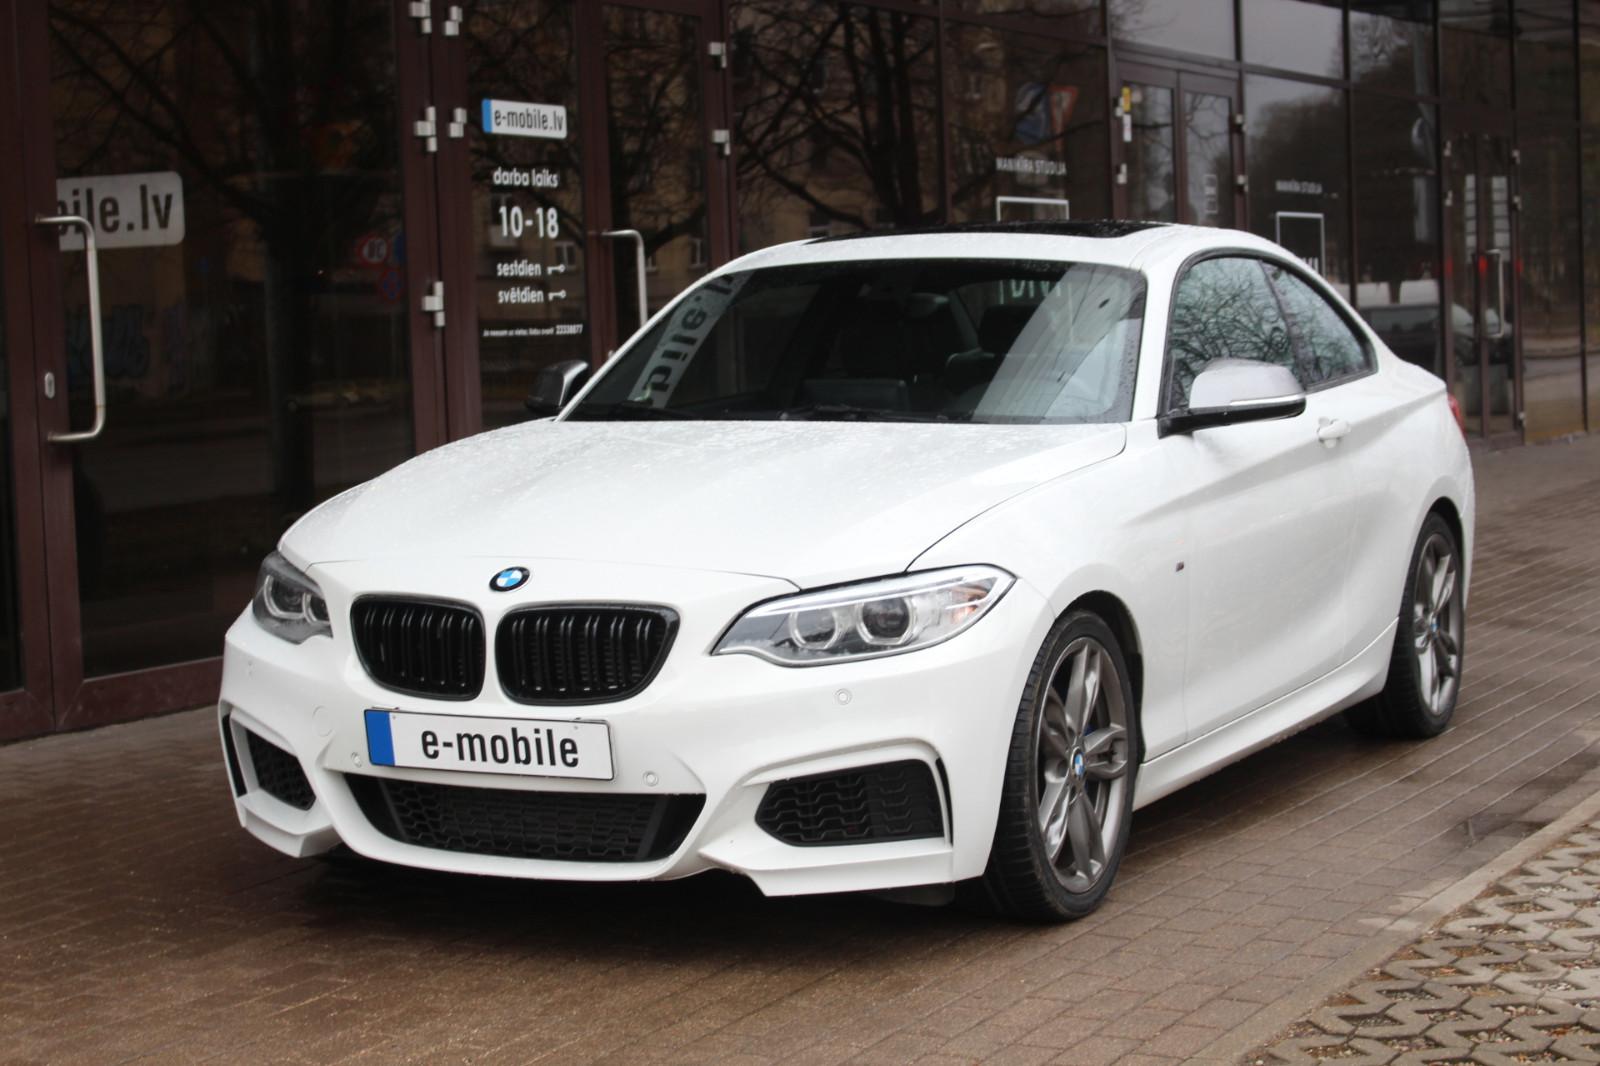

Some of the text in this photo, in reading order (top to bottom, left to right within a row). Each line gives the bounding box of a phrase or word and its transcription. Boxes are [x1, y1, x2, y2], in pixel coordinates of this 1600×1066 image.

[494, 108, 564, 131] e-mobile.lv
[493, 166, 559, 188] darba laiks
[499, 205, 559, 239] 10-18
[497, 258, 542, 277] sestdien
[498, 286, 545, 304] svētdien
[421, 727, 580, 768] e-mobile
